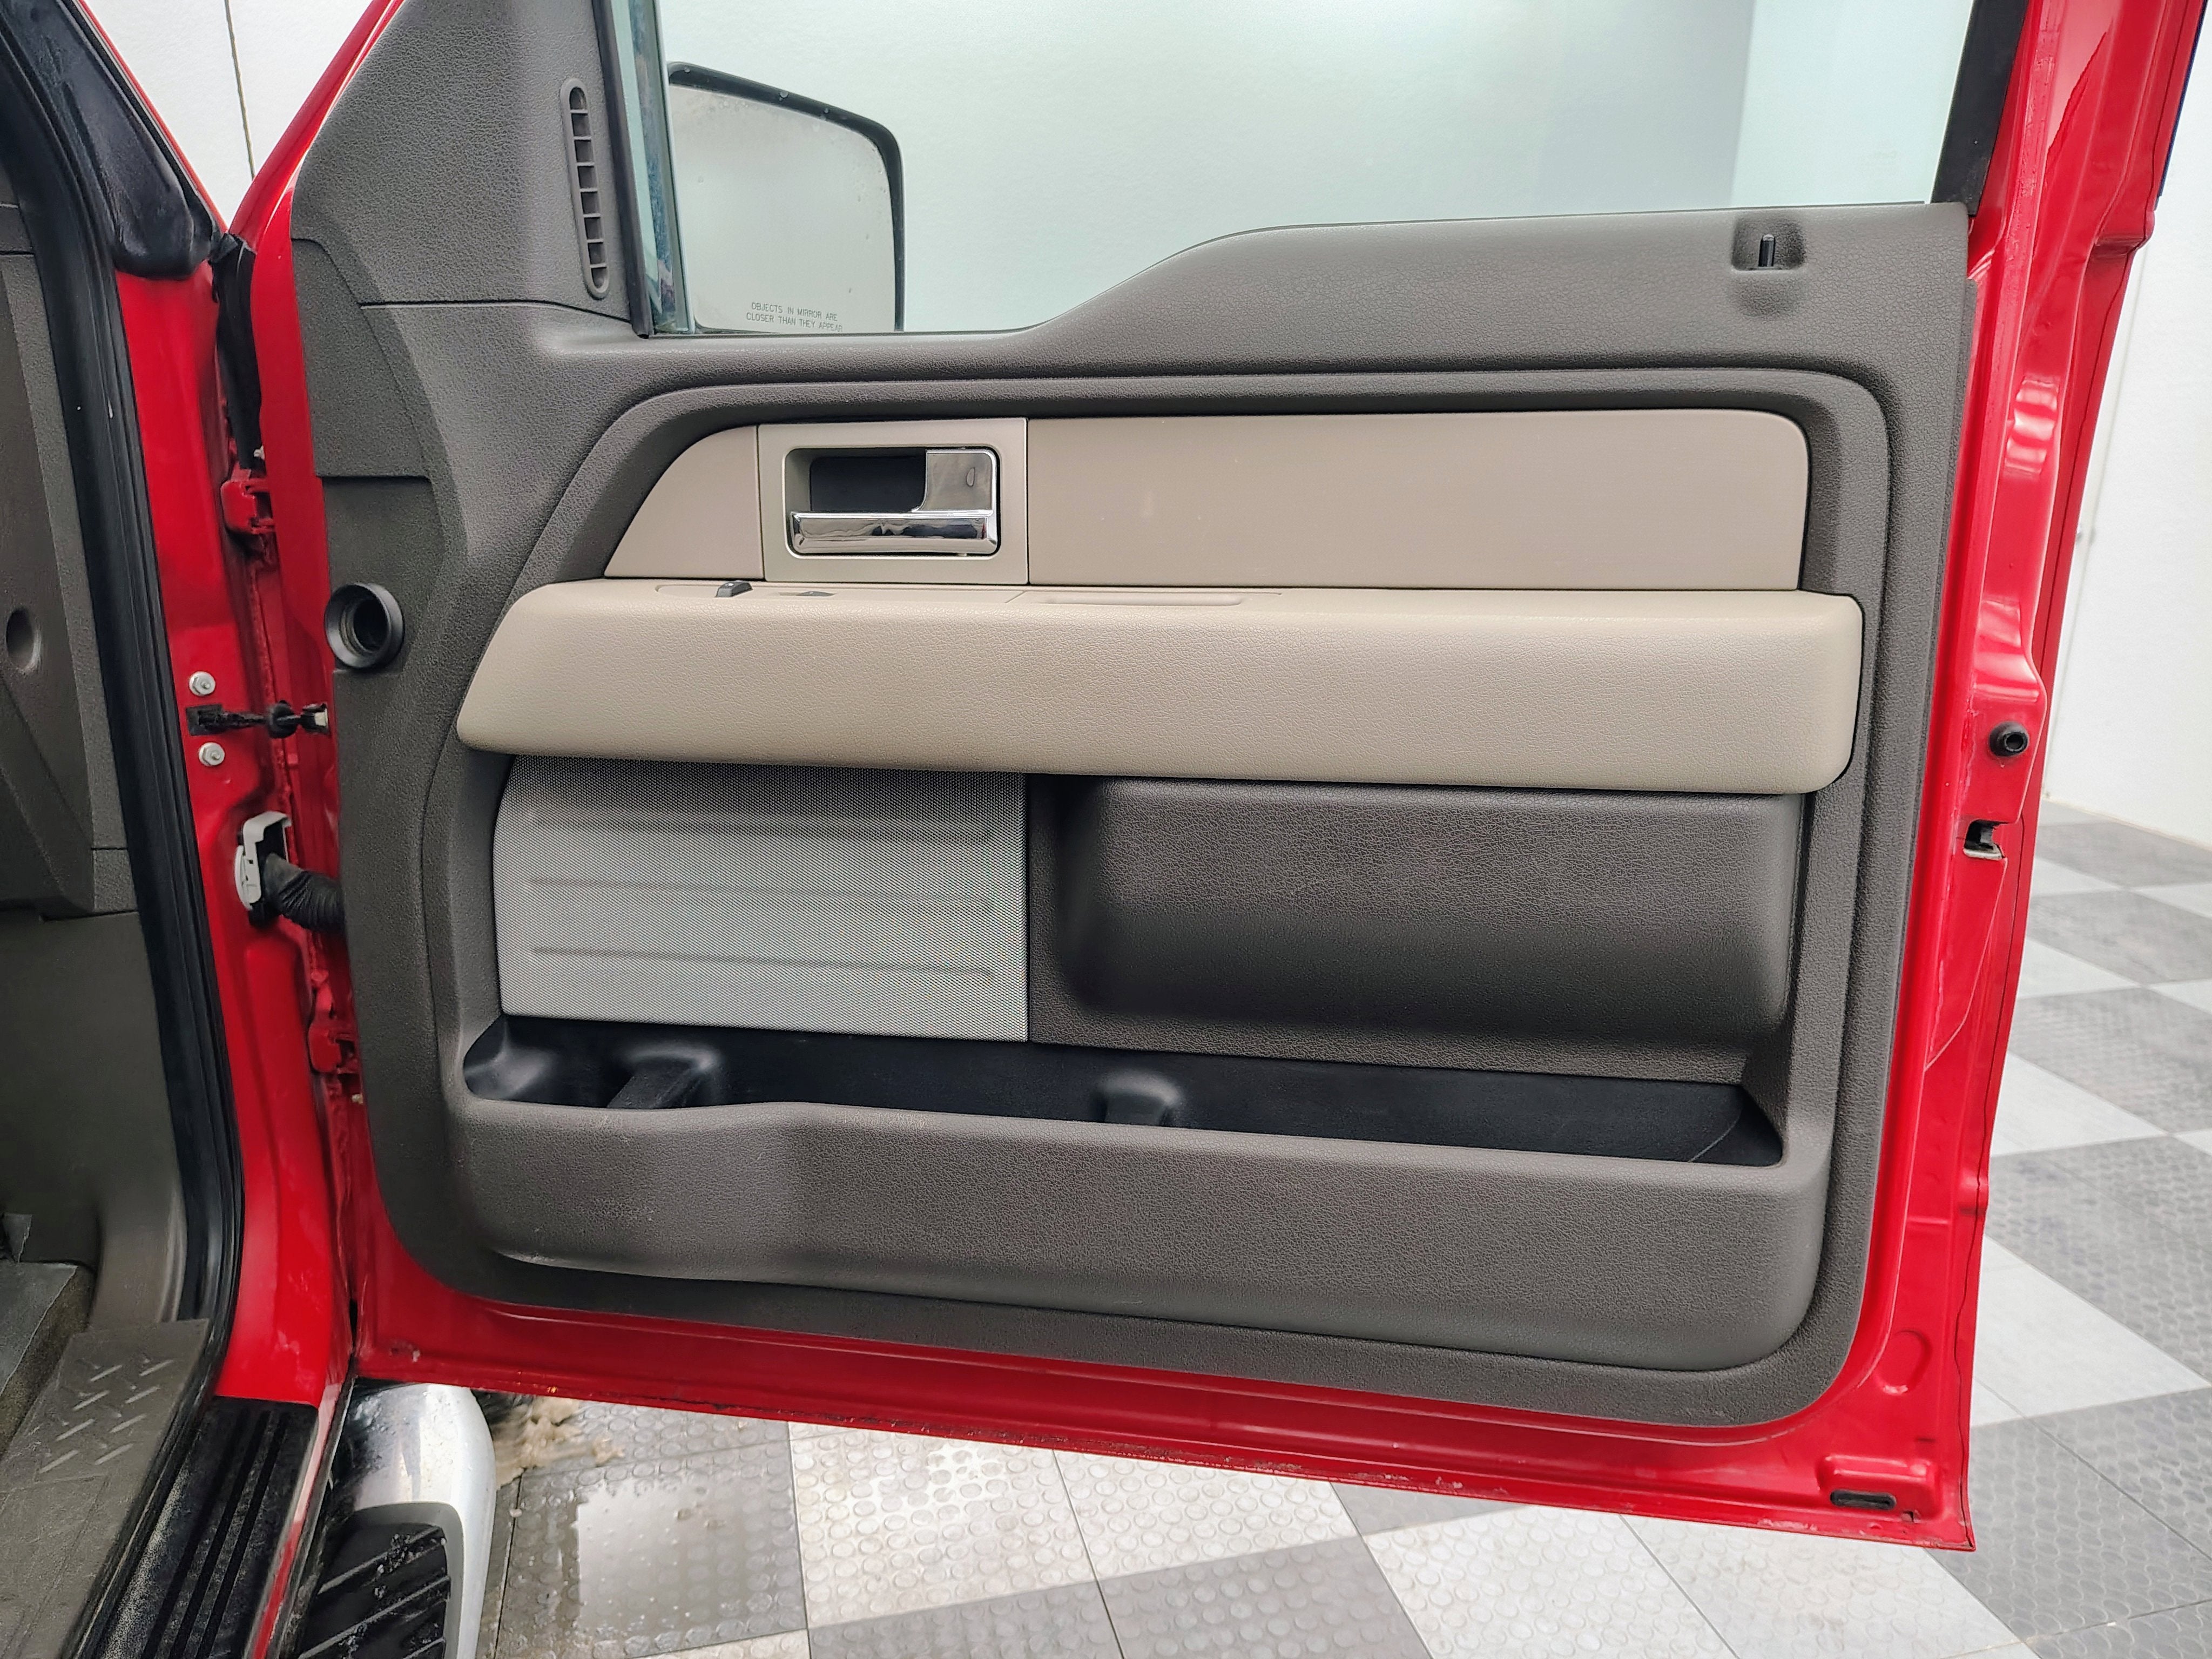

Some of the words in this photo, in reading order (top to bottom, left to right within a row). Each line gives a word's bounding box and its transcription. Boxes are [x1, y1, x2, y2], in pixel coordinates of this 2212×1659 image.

[752, 302, 783, 313] OBJECTS
[787, 306, 794, 315] IN
[797, 308, 822, 319] MIRROR
[826, 313, 838, 321] ARE
[746, 313, 774, 322] CLOSER
[778, 316, 796, 326] THAN
[799, 319, 815, 328] THEY
[819, 323, 842, 332] APPEAR
